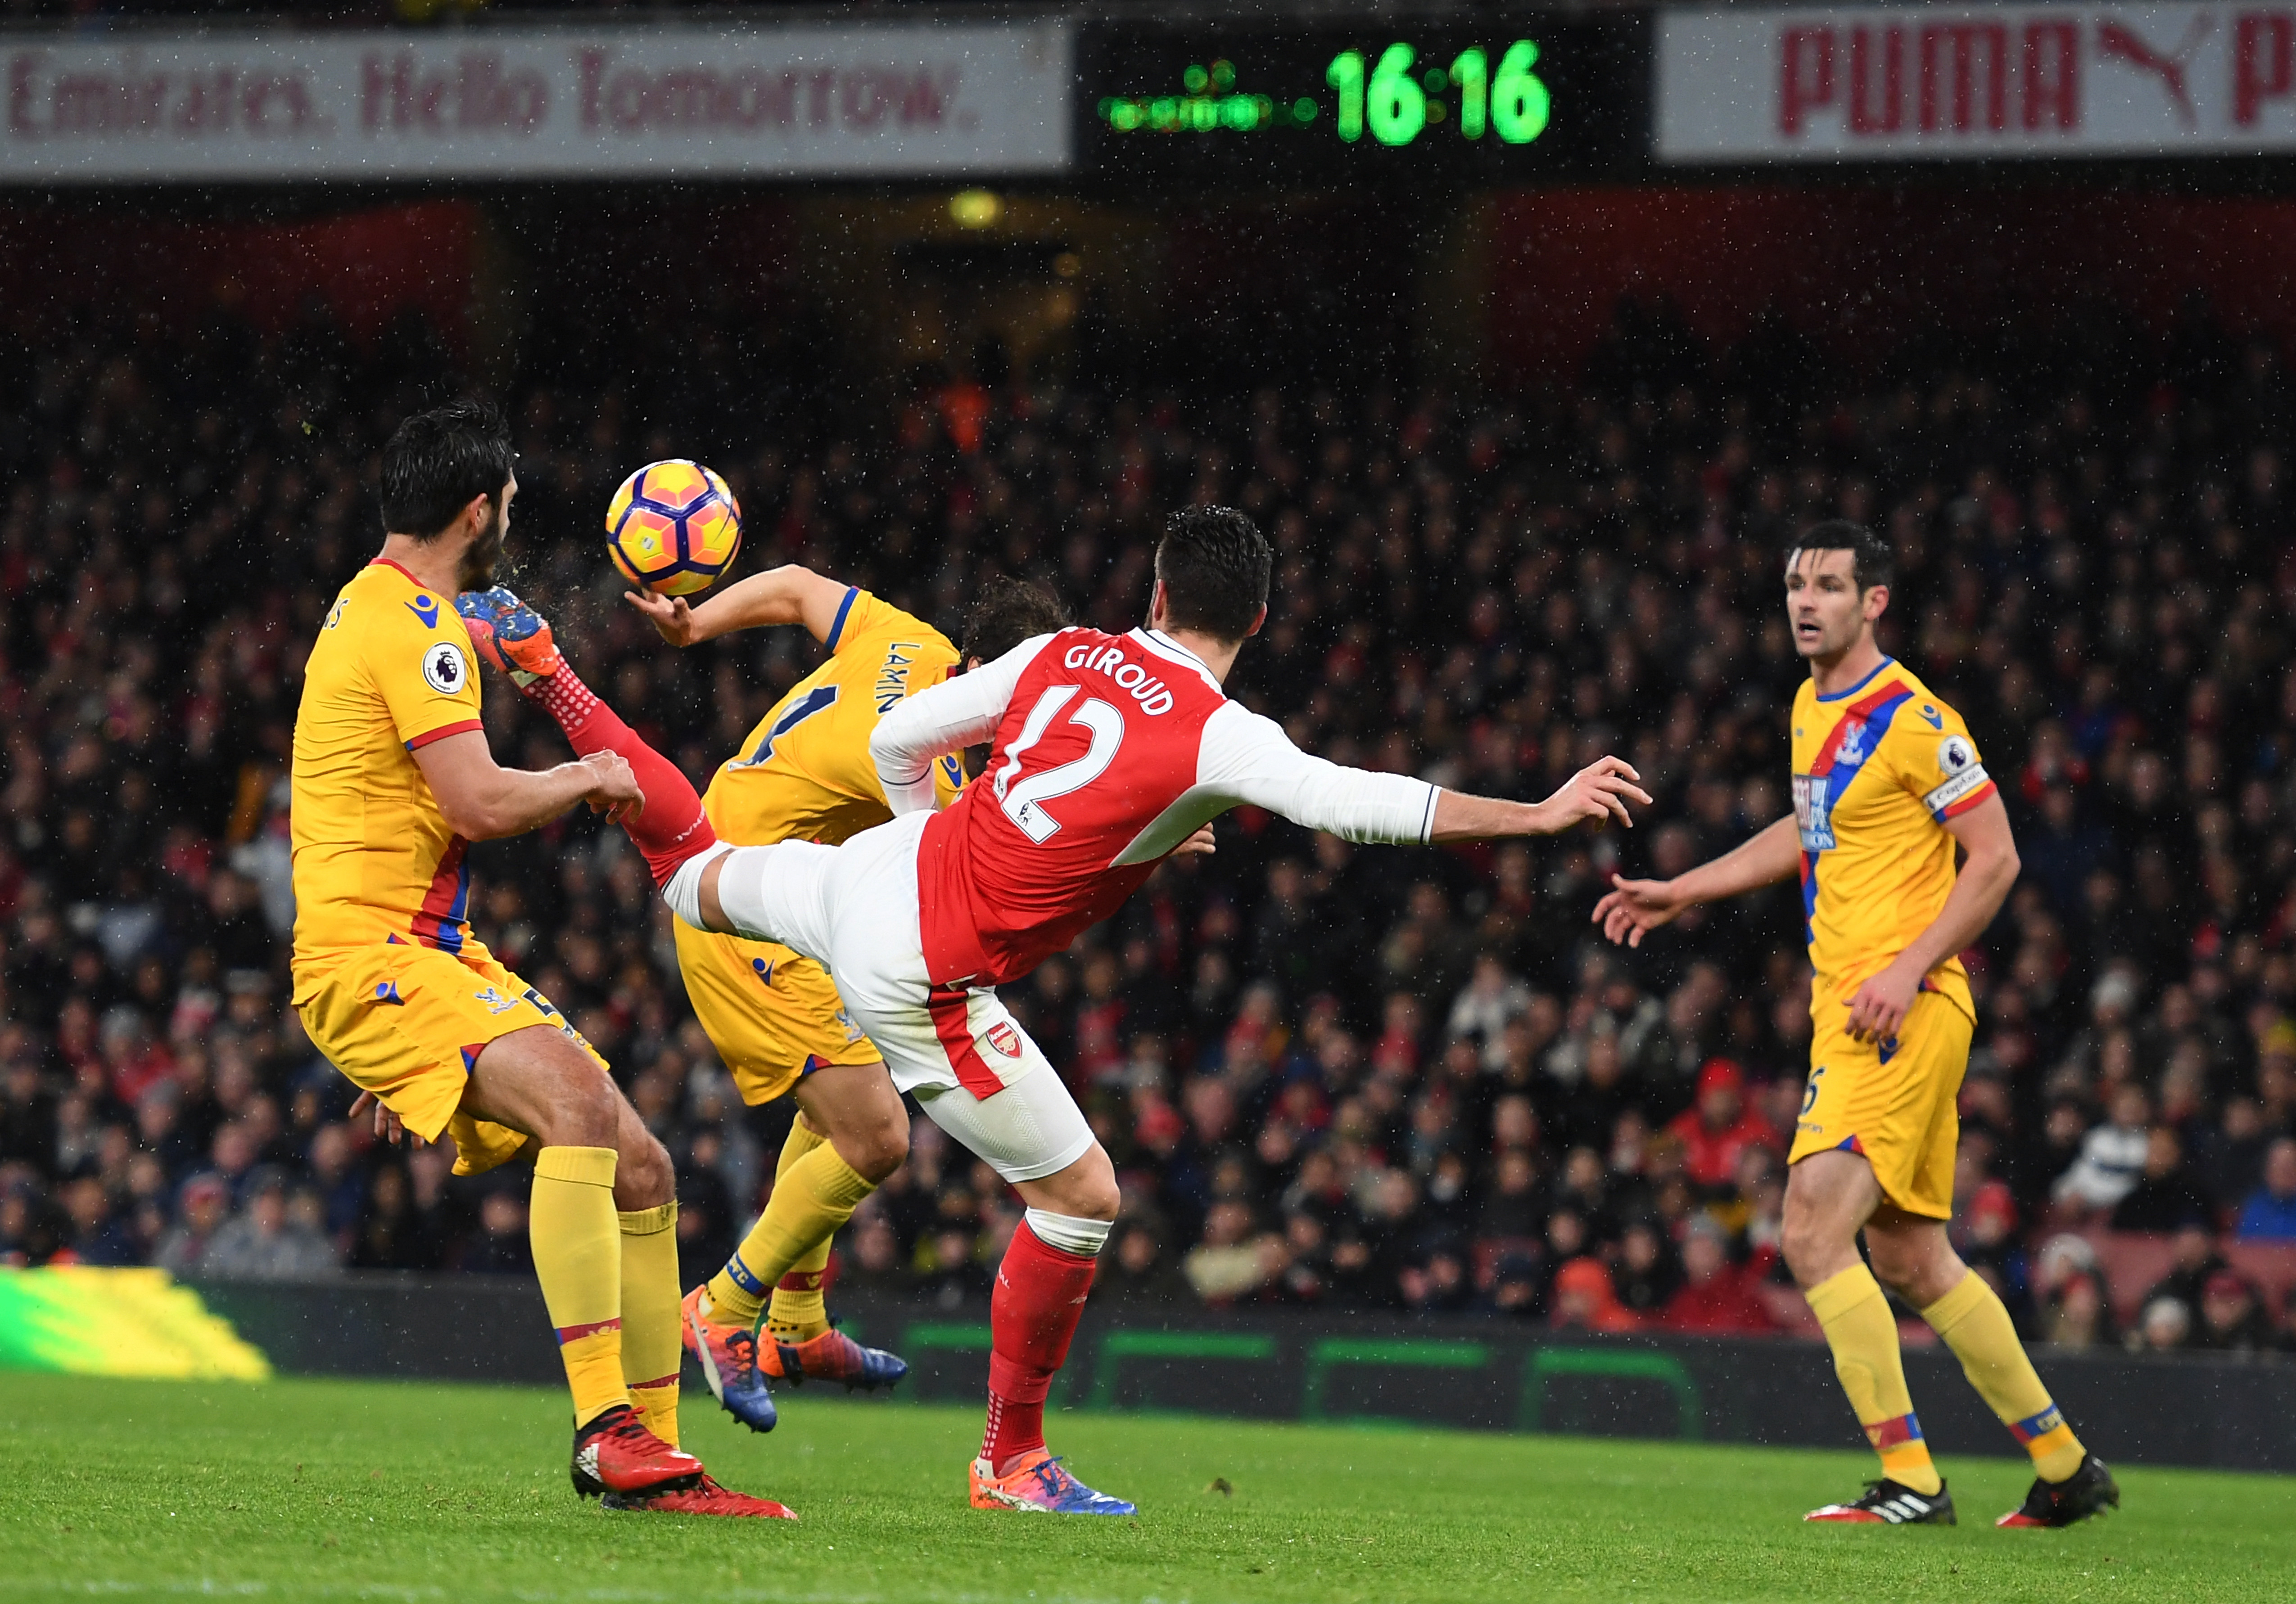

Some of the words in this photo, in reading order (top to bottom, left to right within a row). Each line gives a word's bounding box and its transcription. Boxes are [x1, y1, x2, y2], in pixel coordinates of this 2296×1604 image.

[358, 48, 550, 135] Hello
[1326, 38, 1551, 146] 16:16
[1779, 19, 2079, 136] PUMA
[1064, 644, 1174, 716] GIROUD
[992, 684, 1125, 845] 12
[1801, 1066, 1826, 1116] 6
